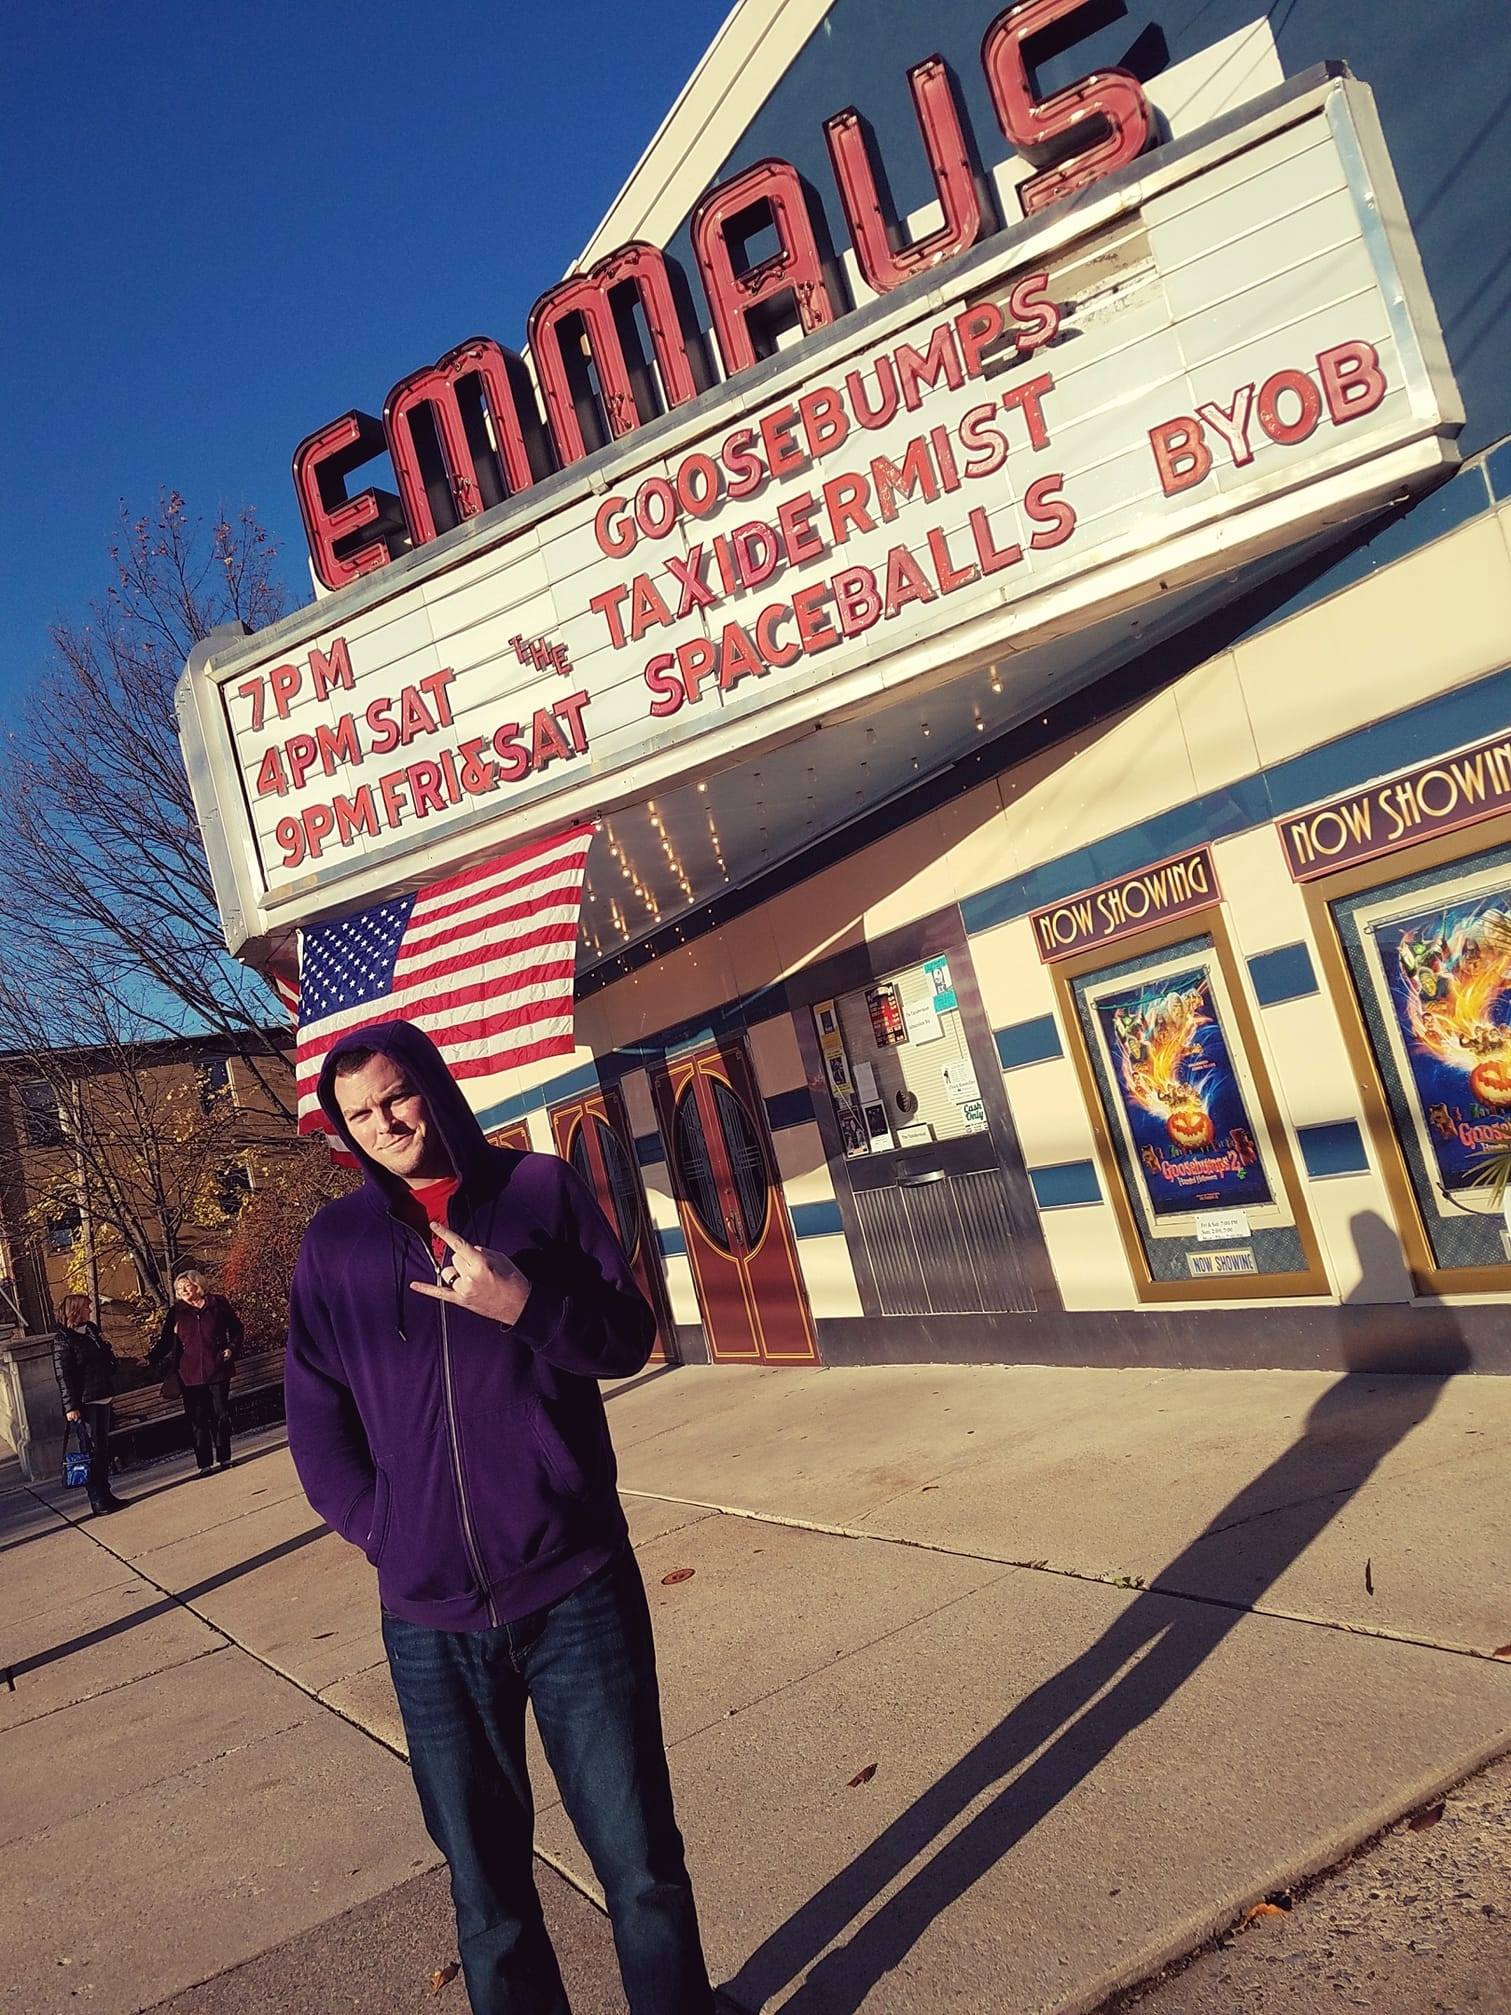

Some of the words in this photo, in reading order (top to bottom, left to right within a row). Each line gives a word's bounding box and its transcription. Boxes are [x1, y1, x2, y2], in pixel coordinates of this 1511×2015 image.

[292, 0, 1154, 592] EMMAUS
[594, 272, 1062, 560] GOOSEBUMPS
[1147, 338, 1388, 498] BYOB
[589, 372, 1056, 650] TAXIDERMIST
[643, 472, 1078, 718] SPACEBALLS
[507, 632, 574, 676] THE
[256, 713, 363, 798] 4PM
[364, 667, 457, 755] SAT
[274, 783, 381, 869] 9PM
[1290, 796, 1373, 865] NOW
[1038, 897, 1094, 952] NOW
[1097, 856, 1209, 936] SHOWING
[964, 1102, 982, 1112] Cash
[966, 1111, 984, 1121] Only
[1161, 1155, 1229, 1183] Goosebumps
[1227, 1150, 1241, 1171] 2
[1192, 1256, 1213, 1273] NOW
